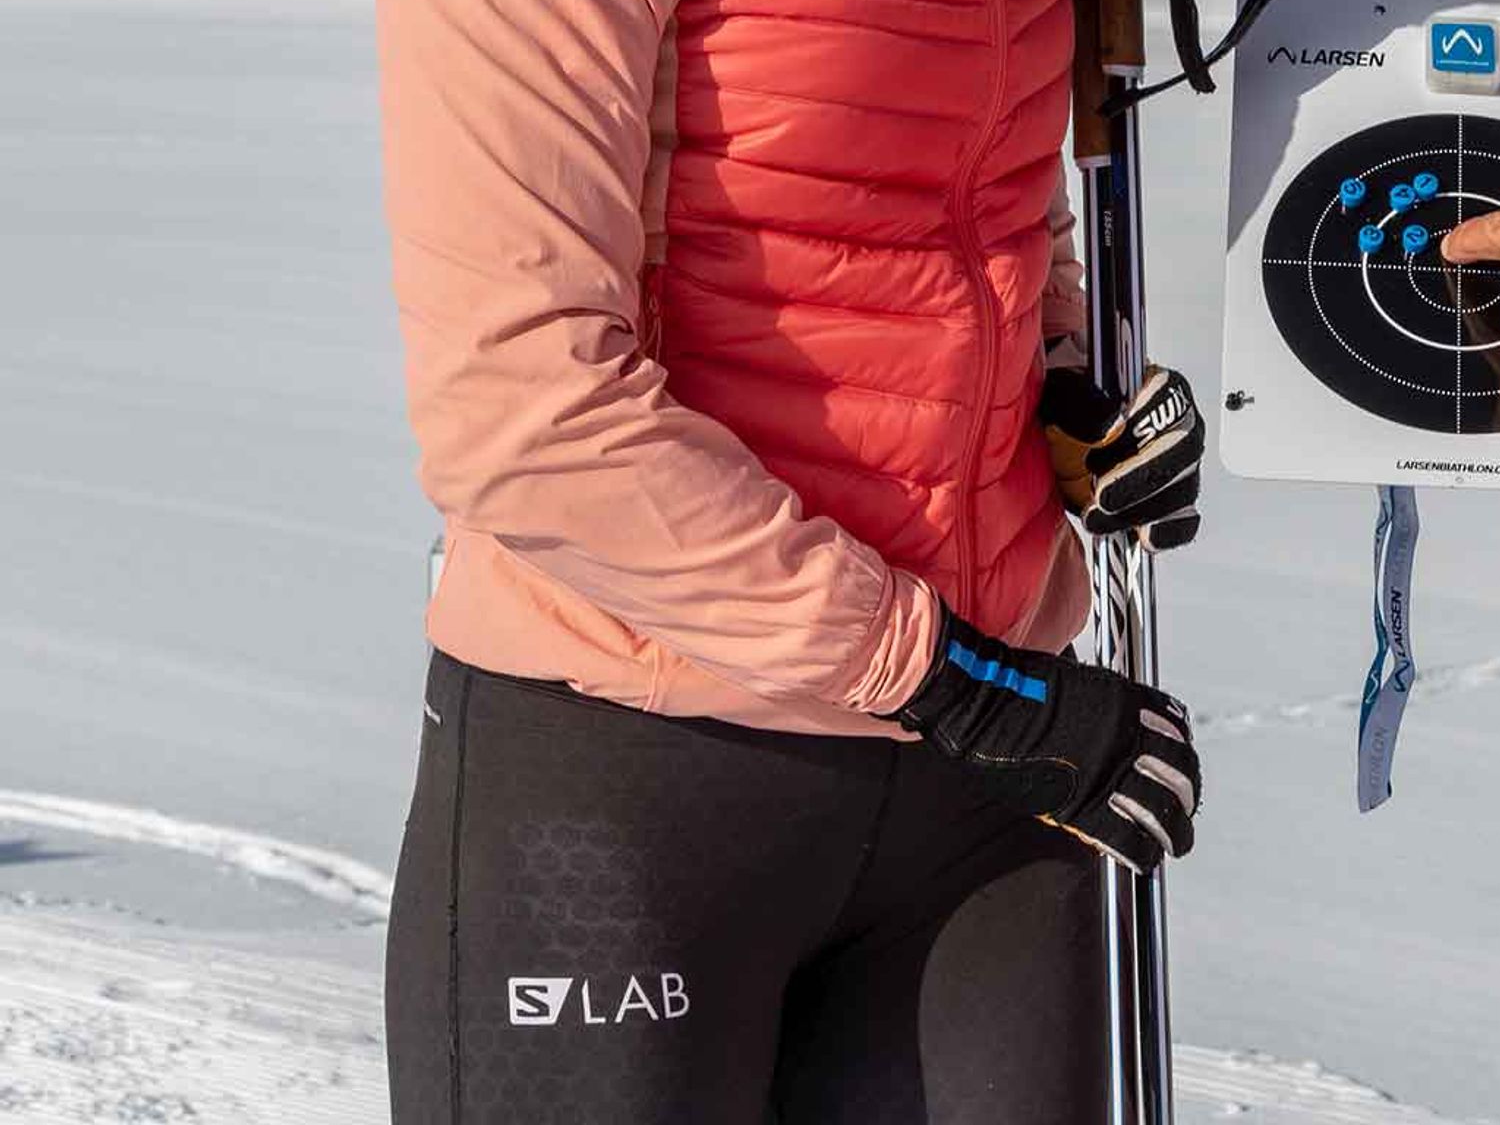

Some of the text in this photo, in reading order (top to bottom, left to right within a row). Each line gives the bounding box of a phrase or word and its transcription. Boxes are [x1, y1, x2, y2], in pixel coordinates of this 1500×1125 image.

[1300, 49, 1386, 68] LARSEN
[1390, 585, 1406, 658] LARSEN
[581, 973, 690, 1024] LAB
